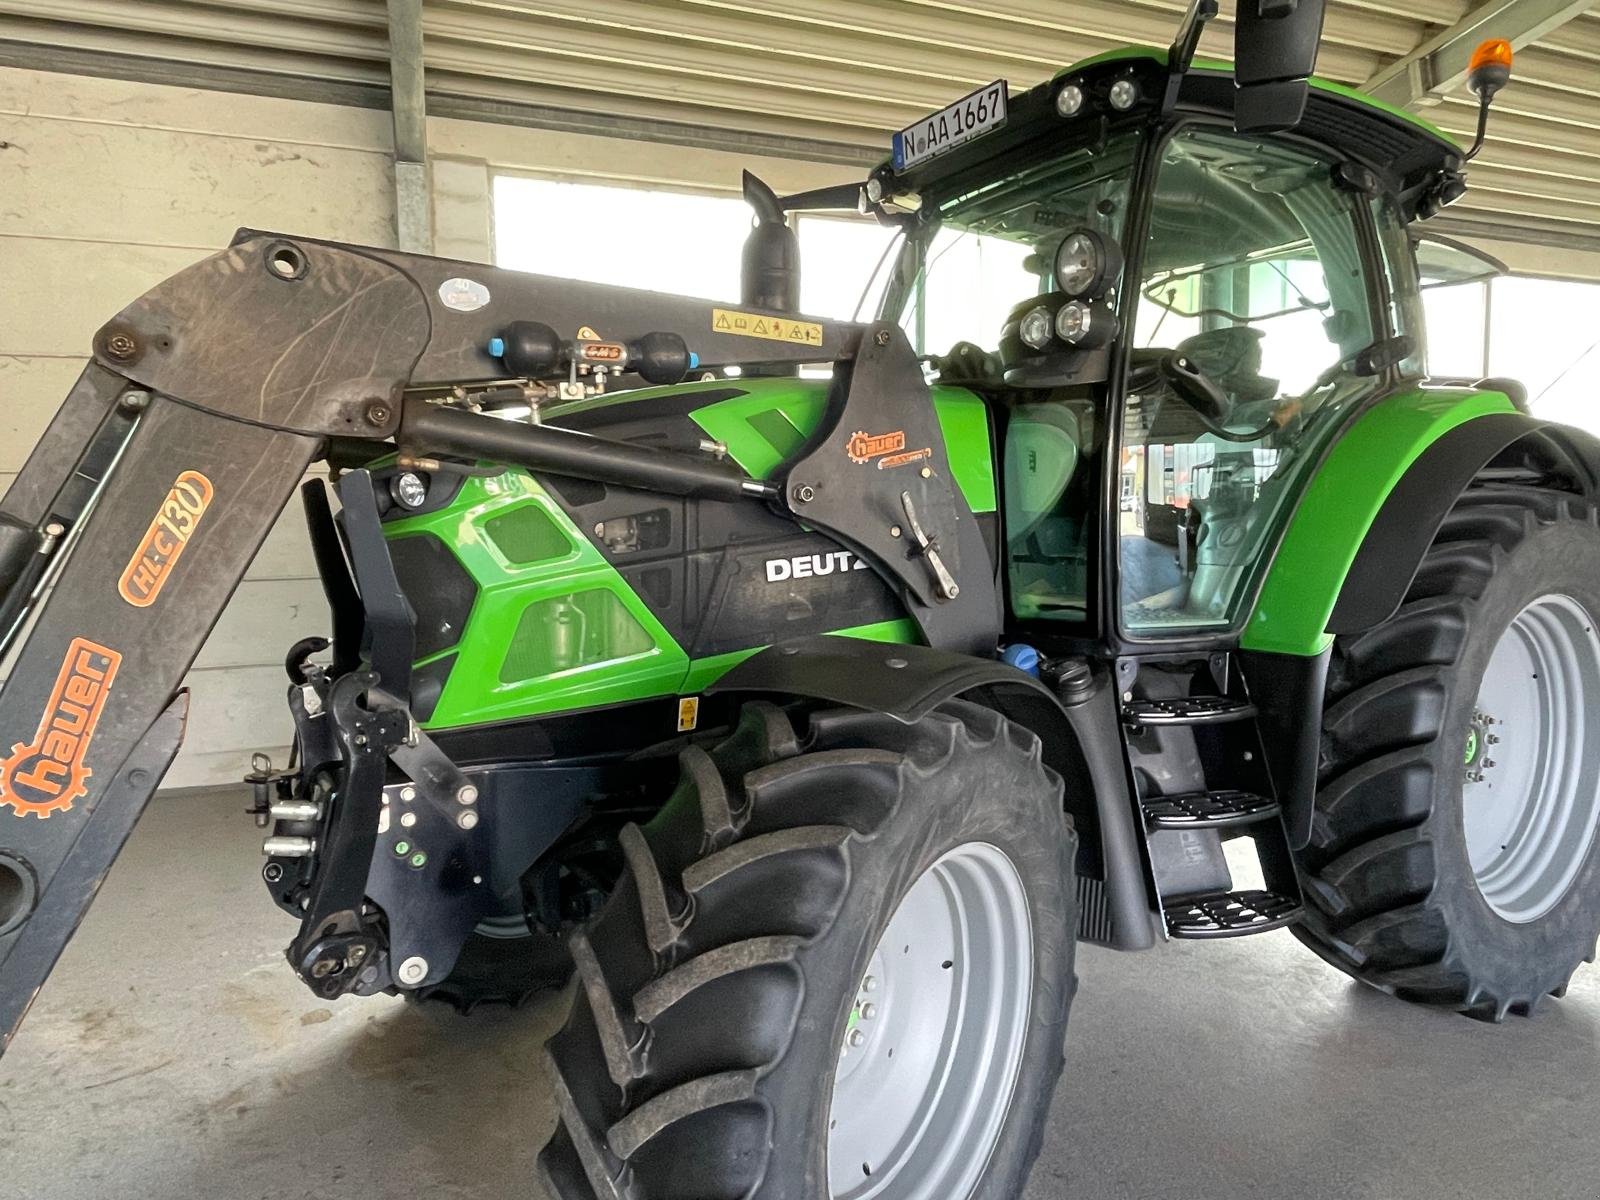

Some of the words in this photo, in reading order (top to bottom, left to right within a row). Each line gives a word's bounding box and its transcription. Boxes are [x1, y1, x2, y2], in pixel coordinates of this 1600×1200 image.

[904, 131, 915, 161] N
[927, 115, 950, 149] AA
[953, 88, 999, 137] 1667
[855, 435, 902, 457] hauer
[156, 481, 204, 543] 130
[14, 649, 106, 796] hauer
